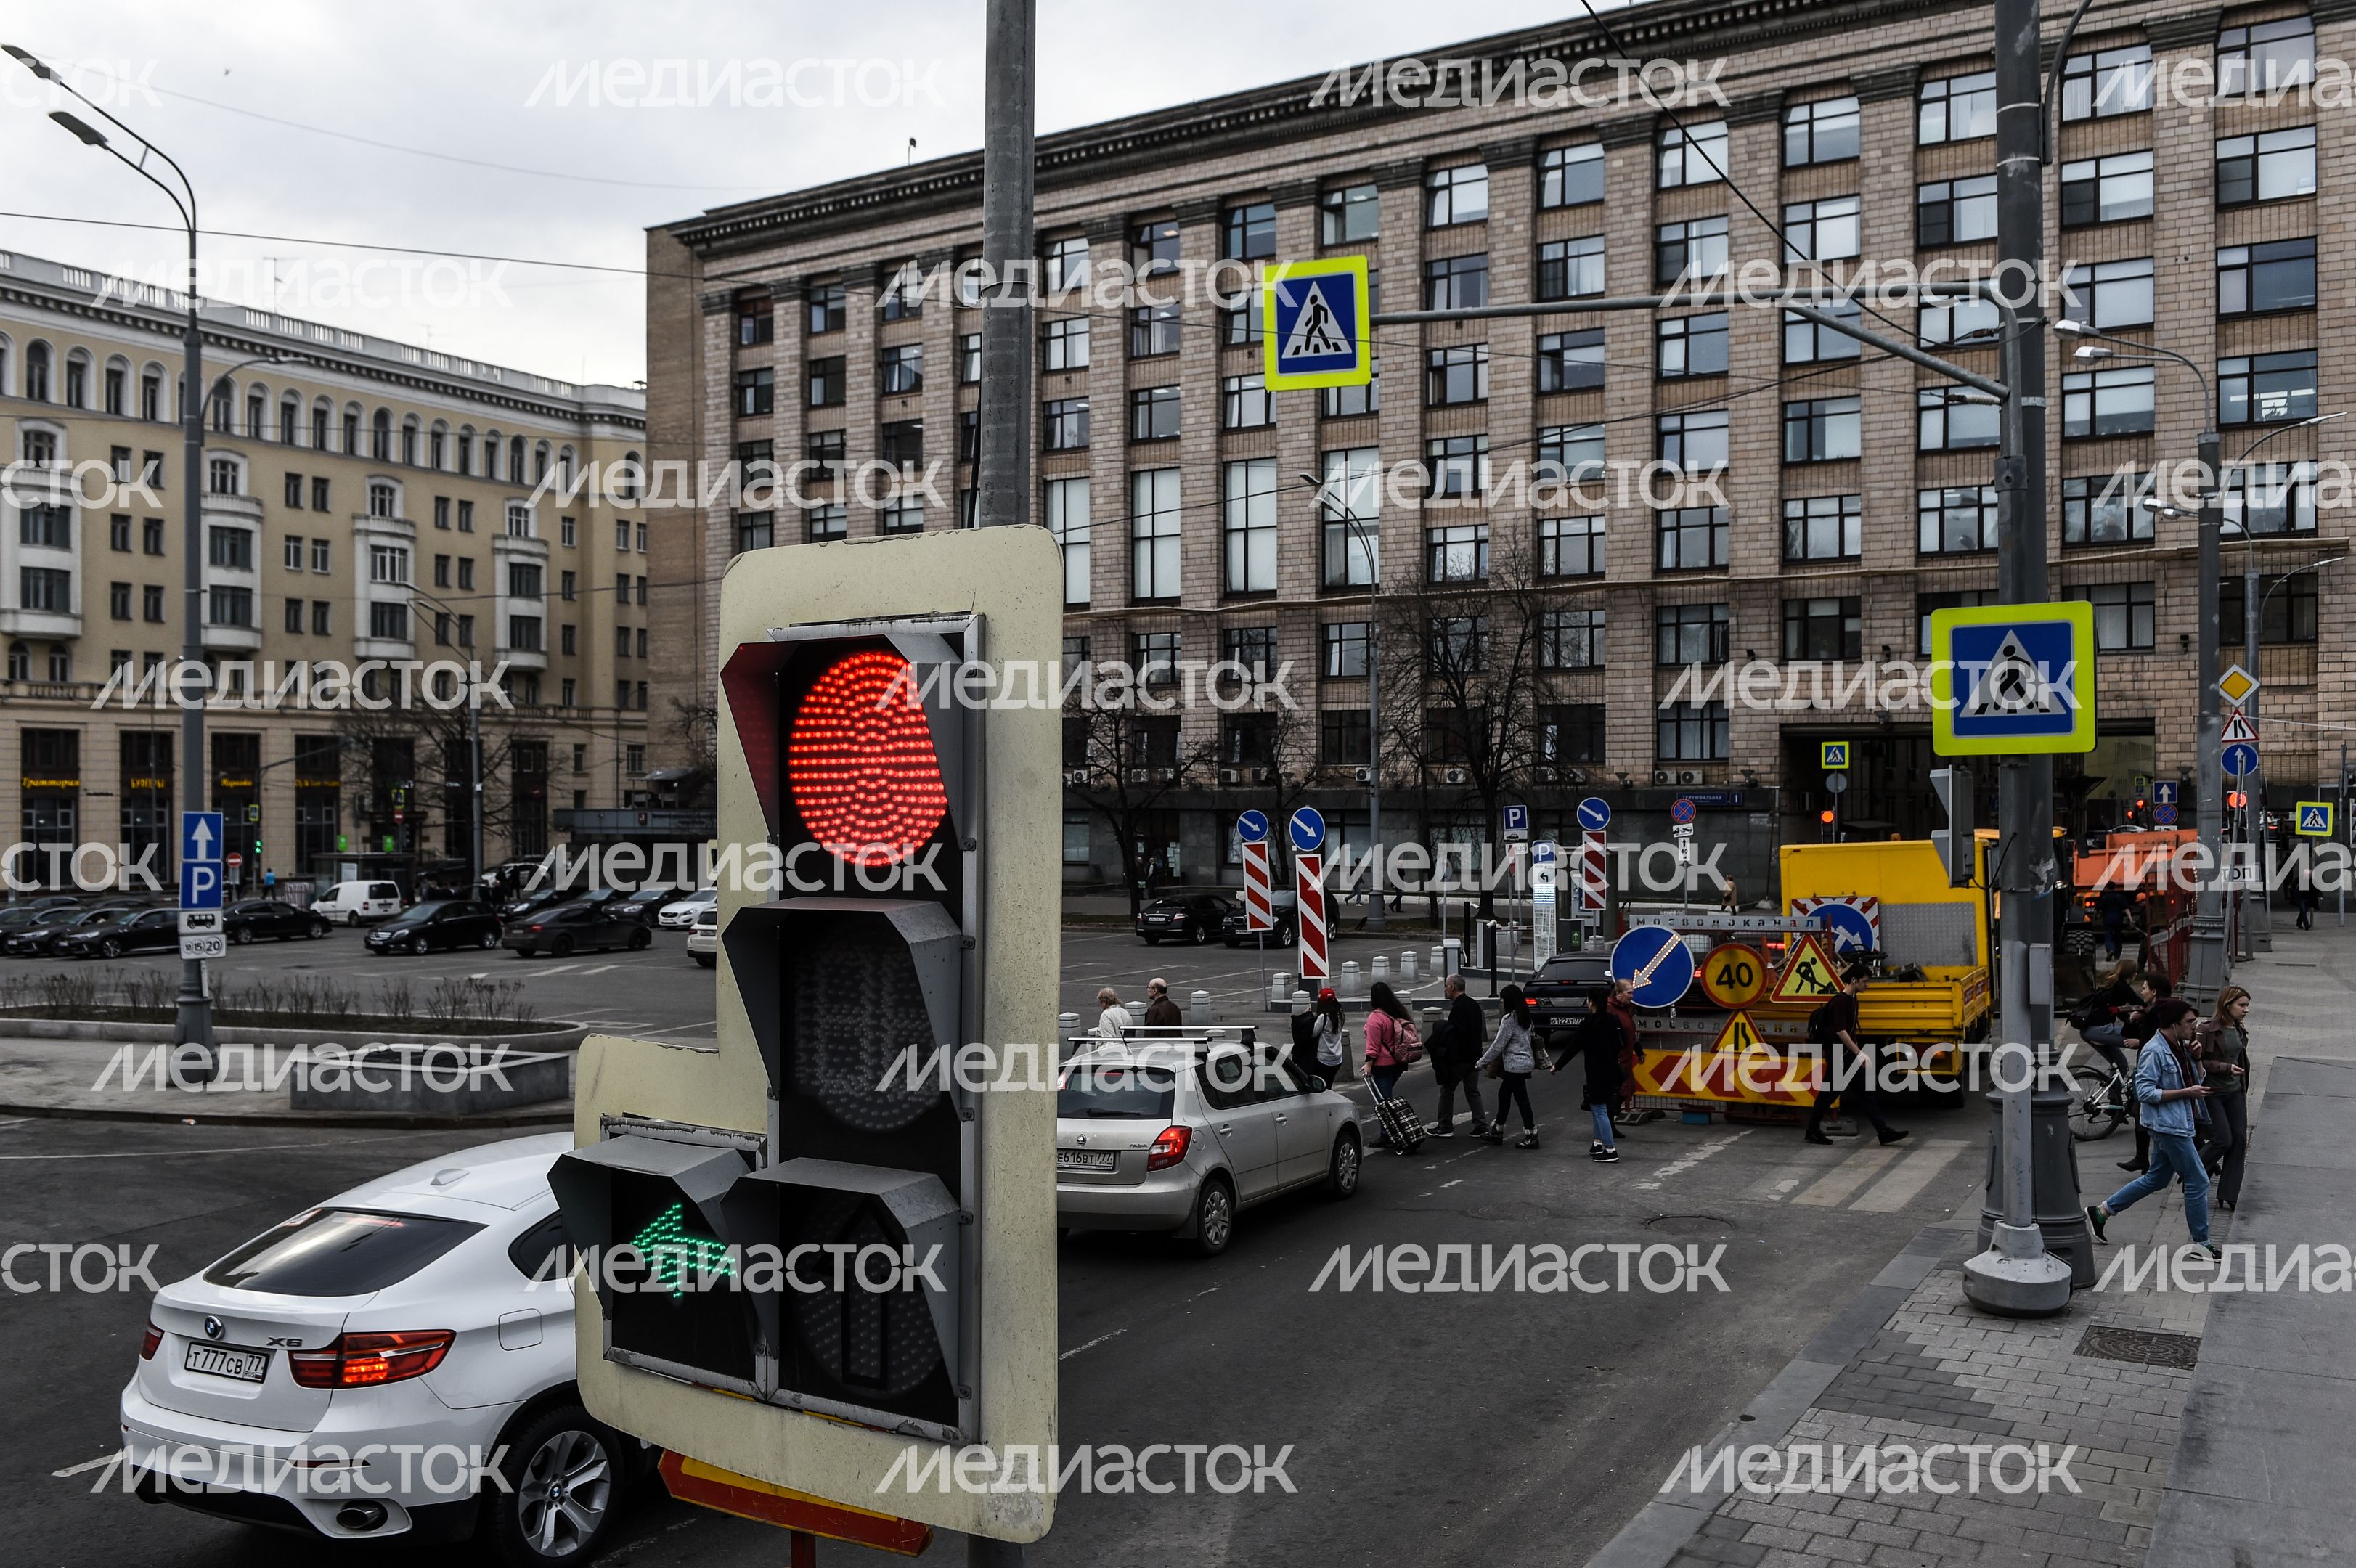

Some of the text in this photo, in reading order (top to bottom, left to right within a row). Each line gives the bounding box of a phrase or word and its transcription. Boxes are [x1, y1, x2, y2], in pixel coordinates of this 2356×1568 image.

[2222, 867, 2252, 880] ТОП
[194, 942, 203, 951] 15
[205, 941, 220, 951] 20
[1716, 962, 1753, 989] 40
[266, 1336, 303, 1347] X6
[247, 1355, 262, 1372] 77
